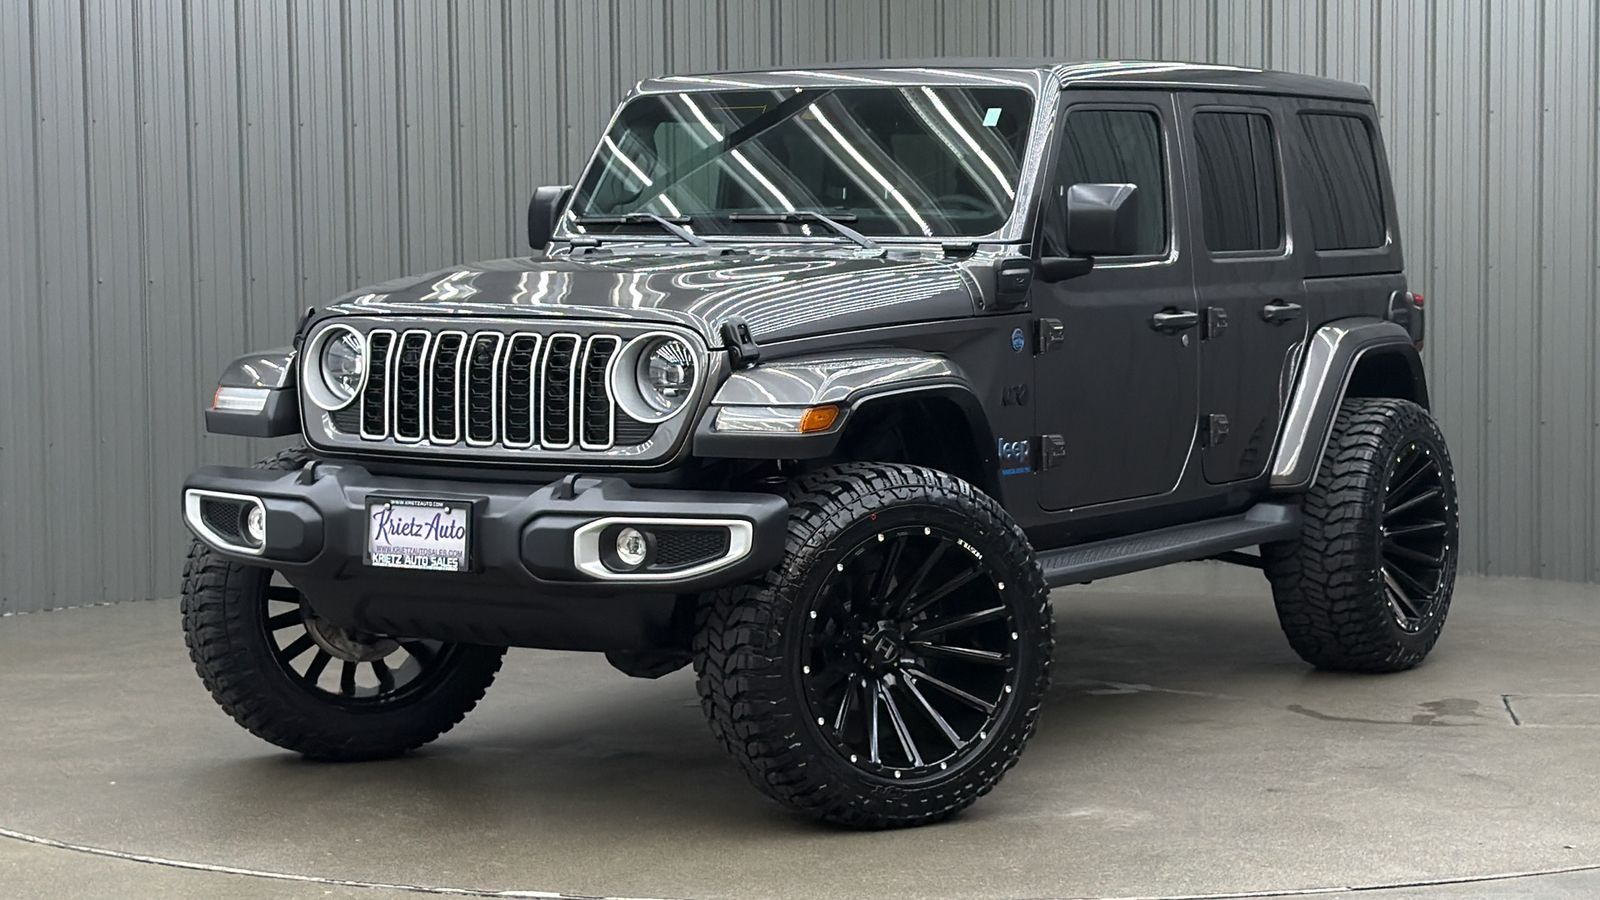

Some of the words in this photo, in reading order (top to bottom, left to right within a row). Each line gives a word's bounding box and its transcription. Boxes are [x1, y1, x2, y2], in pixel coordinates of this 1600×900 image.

[373, 508, 423, 545] Krietz
[424, 512, 465, 541] Auto
[372, 553, 402, 566] KRIETZ
[405, 556, 429, 567] AUTO
[431, 558, 458, 569] SALES
